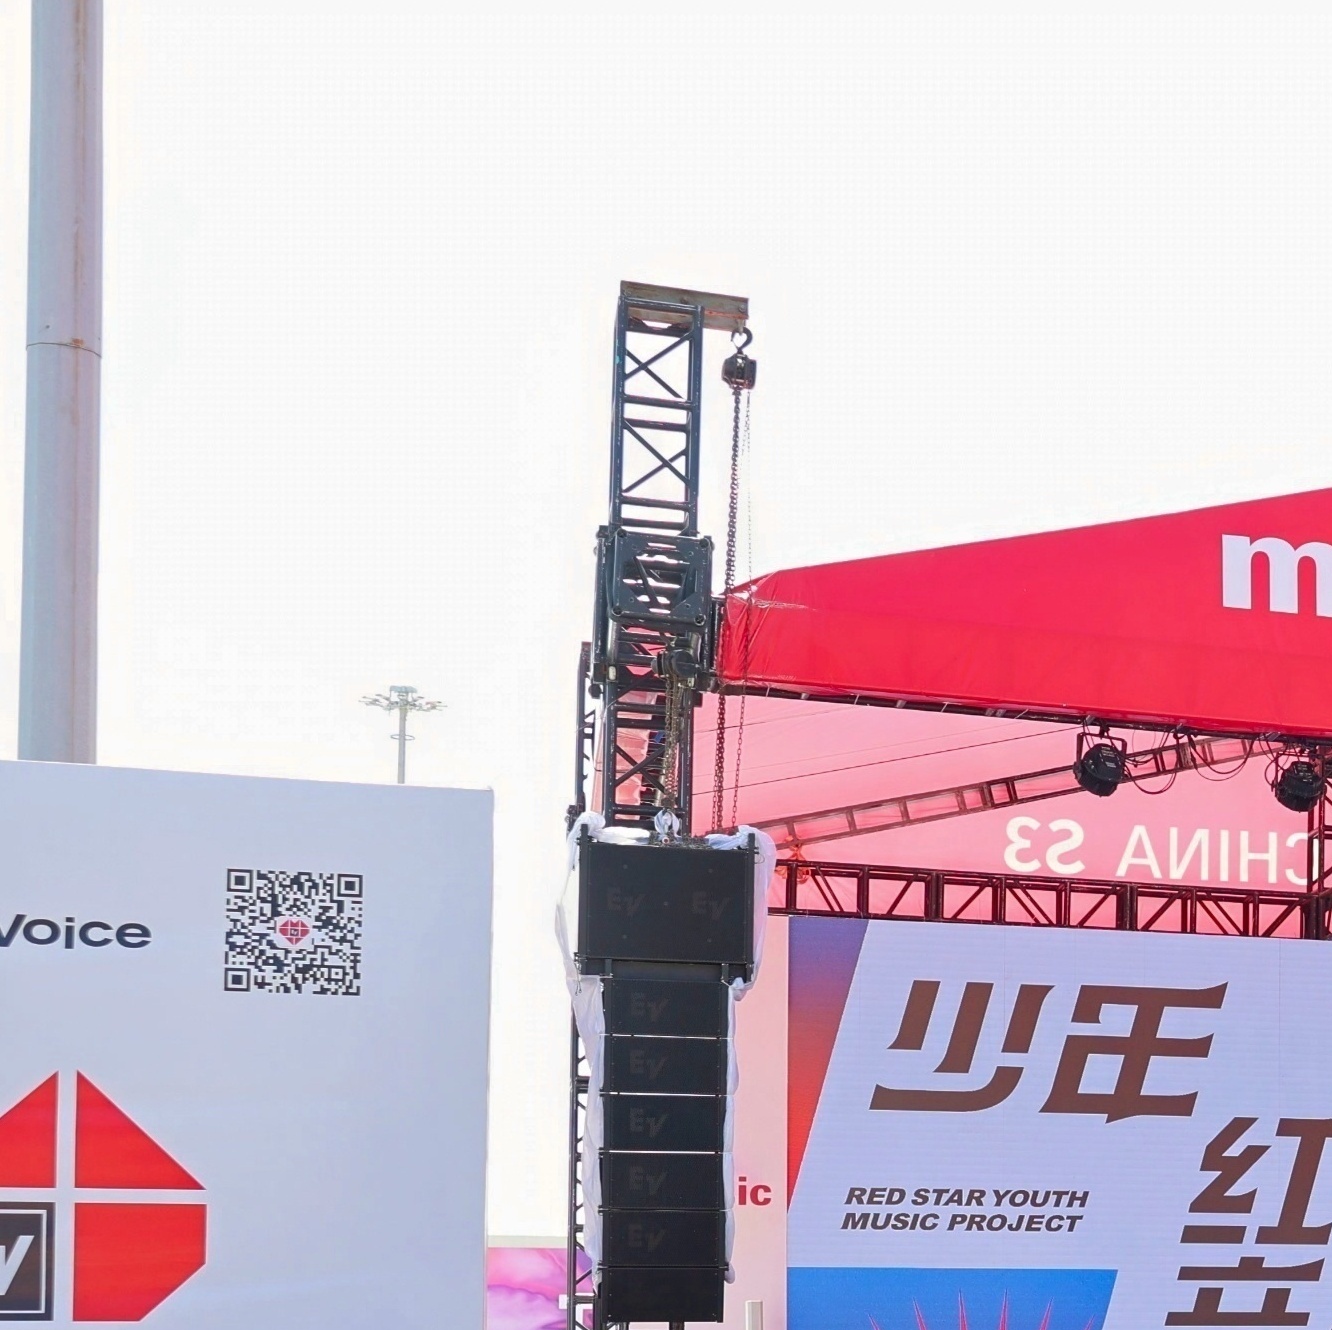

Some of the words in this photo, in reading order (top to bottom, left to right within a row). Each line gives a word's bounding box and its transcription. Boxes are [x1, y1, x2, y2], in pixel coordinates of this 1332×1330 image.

[869, 980, 1229, 1124] 少年
[844, 1186, 905, 1206] RED
[911, 1187, 985, 1208] STAR
[991, 1189, 1090, 1210] YOUTH
[840, 1211, 940, 1232] MUSIC
[947, 1213, 1083, 1234] PROJECT
